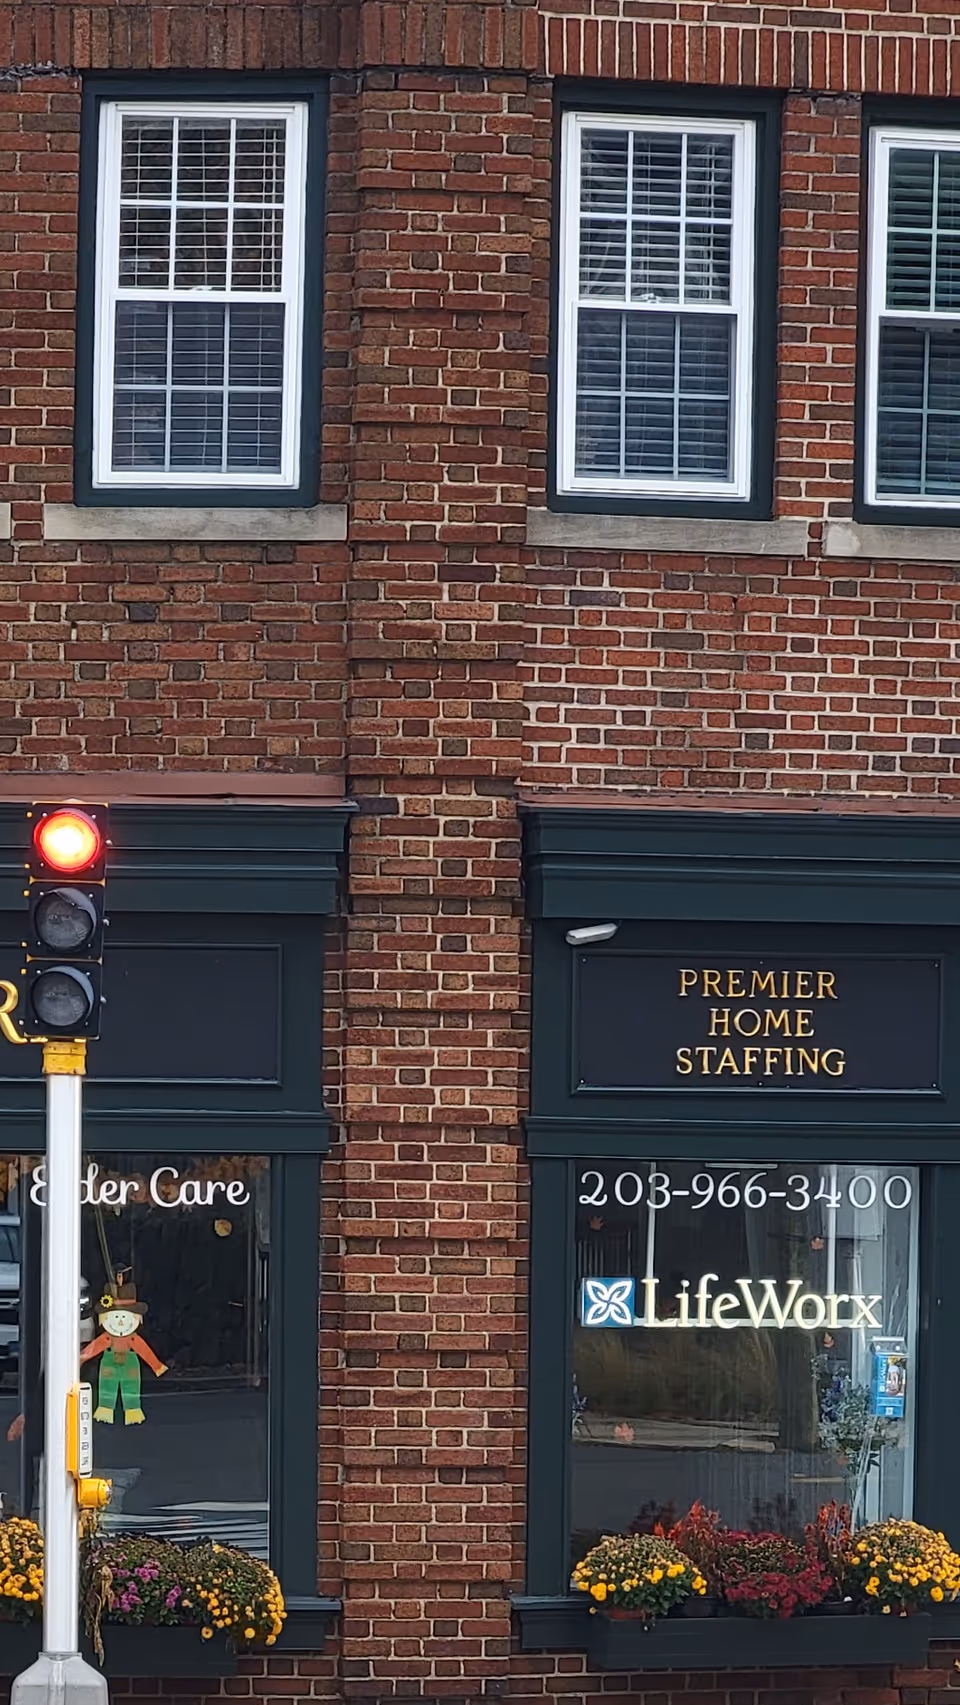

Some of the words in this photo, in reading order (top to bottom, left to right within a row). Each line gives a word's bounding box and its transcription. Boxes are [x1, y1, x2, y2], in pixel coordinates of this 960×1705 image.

[678, 968, 839, 1000] PREMIER
[708, 1009, 815, 1038] HOME
[676, 1046, 846, 1077] STAFFING
[30, 1163, 139, 1207] Eder
[150, 1166, 250, 1208] Care
[579, 1169, 914, 1212] 203-966-3400
[642, 1273, 884, 1330] LifeWorx
